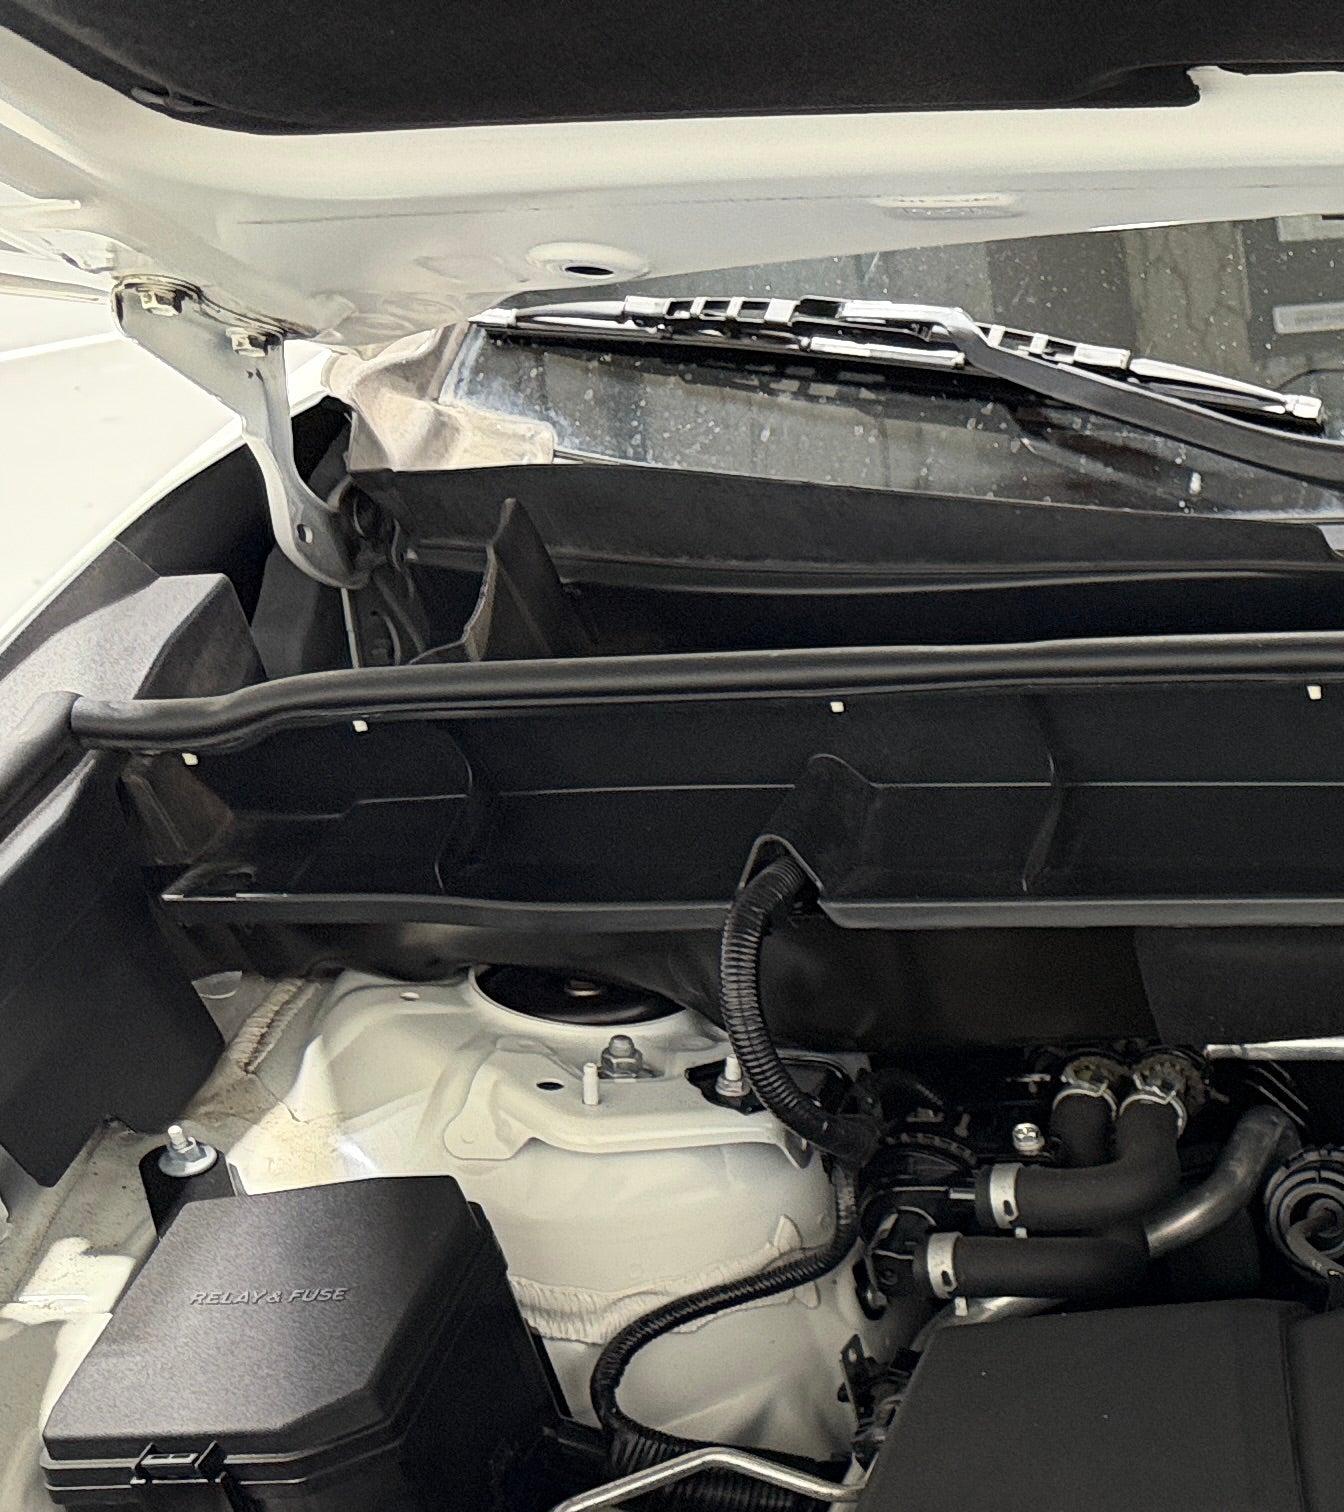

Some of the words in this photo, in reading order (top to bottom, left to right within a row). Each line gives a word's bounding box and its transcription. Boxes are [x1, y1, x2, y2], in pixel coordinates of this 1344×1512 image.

[189, 1289, 268, 1306] RELAY
[266, 1289, 282, 1304] &
[288, 1287, 351, 1303] FUSE
